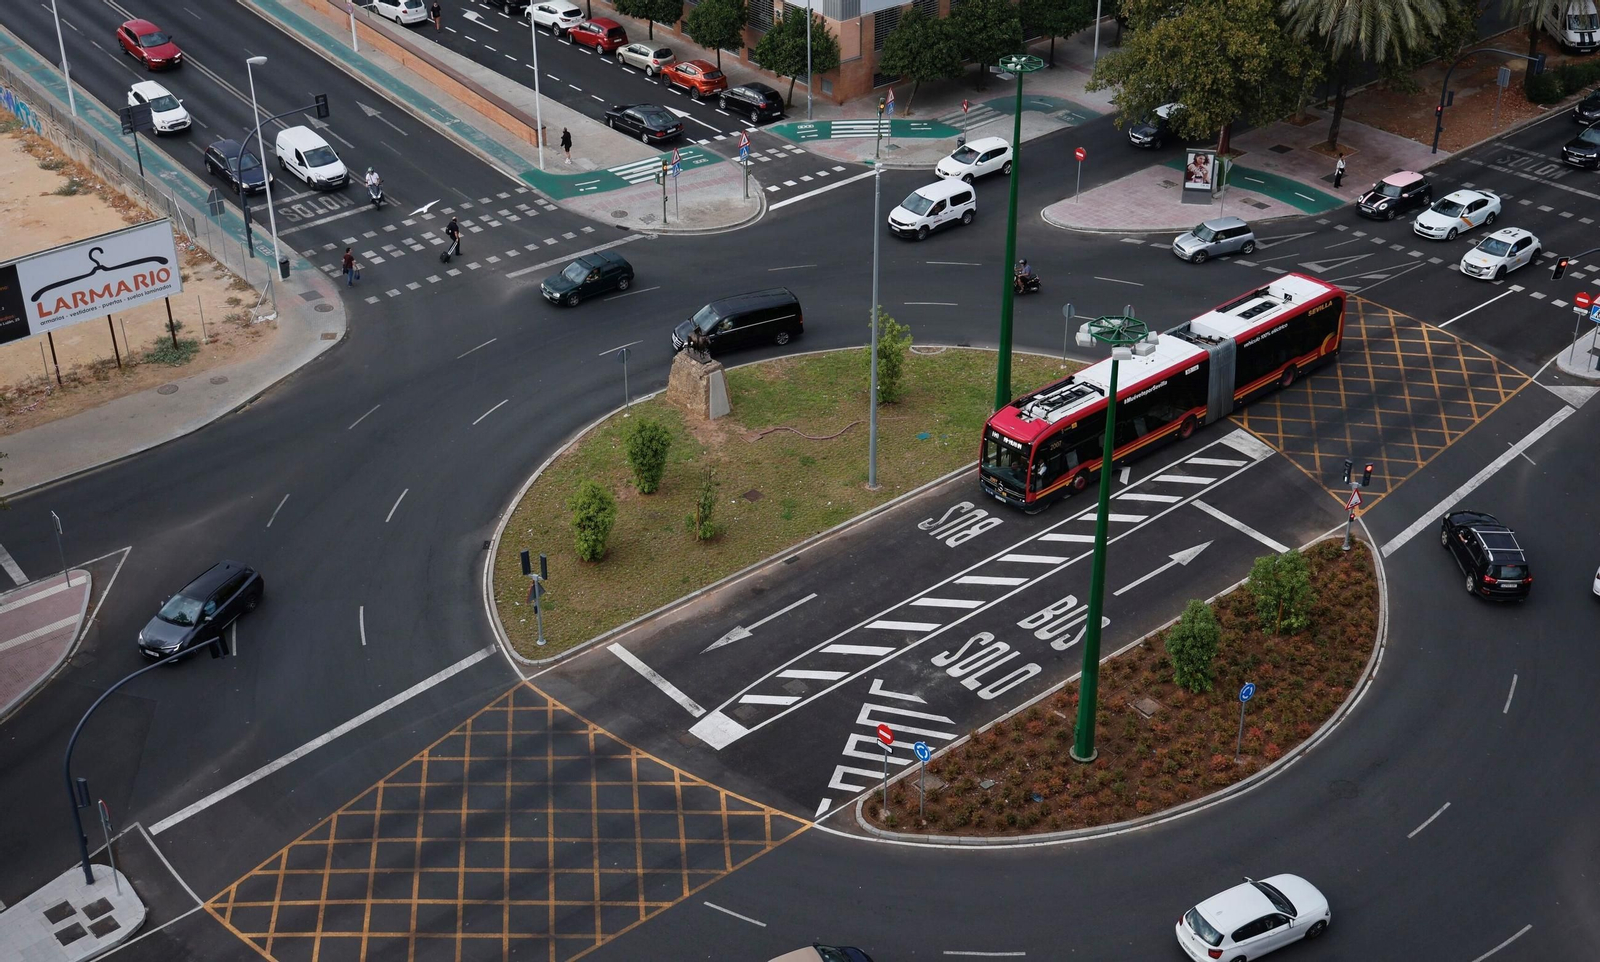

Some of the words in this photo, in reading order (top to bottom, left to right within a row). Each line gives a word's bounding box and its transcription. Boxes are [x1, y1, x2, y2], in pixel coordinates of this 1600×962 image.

[278, 193, 355, 222] MOTOS
[37, 268, 170, 318] LARMARIO
[40, 315, 65, 326] armarios
[69, 305, 98, 317] vestidores
[102, 297, 123, 309] puertas
[127, 292, 144, 301] suelos
[145, 284, 172, 296] laminados
[1308, 300, 1333, 316] SEVILLA
[917, 501, 1004, 548] BUS
[1016, 594, 1111, 651] BUS
[930, 631, 1043, 700] SOLO
